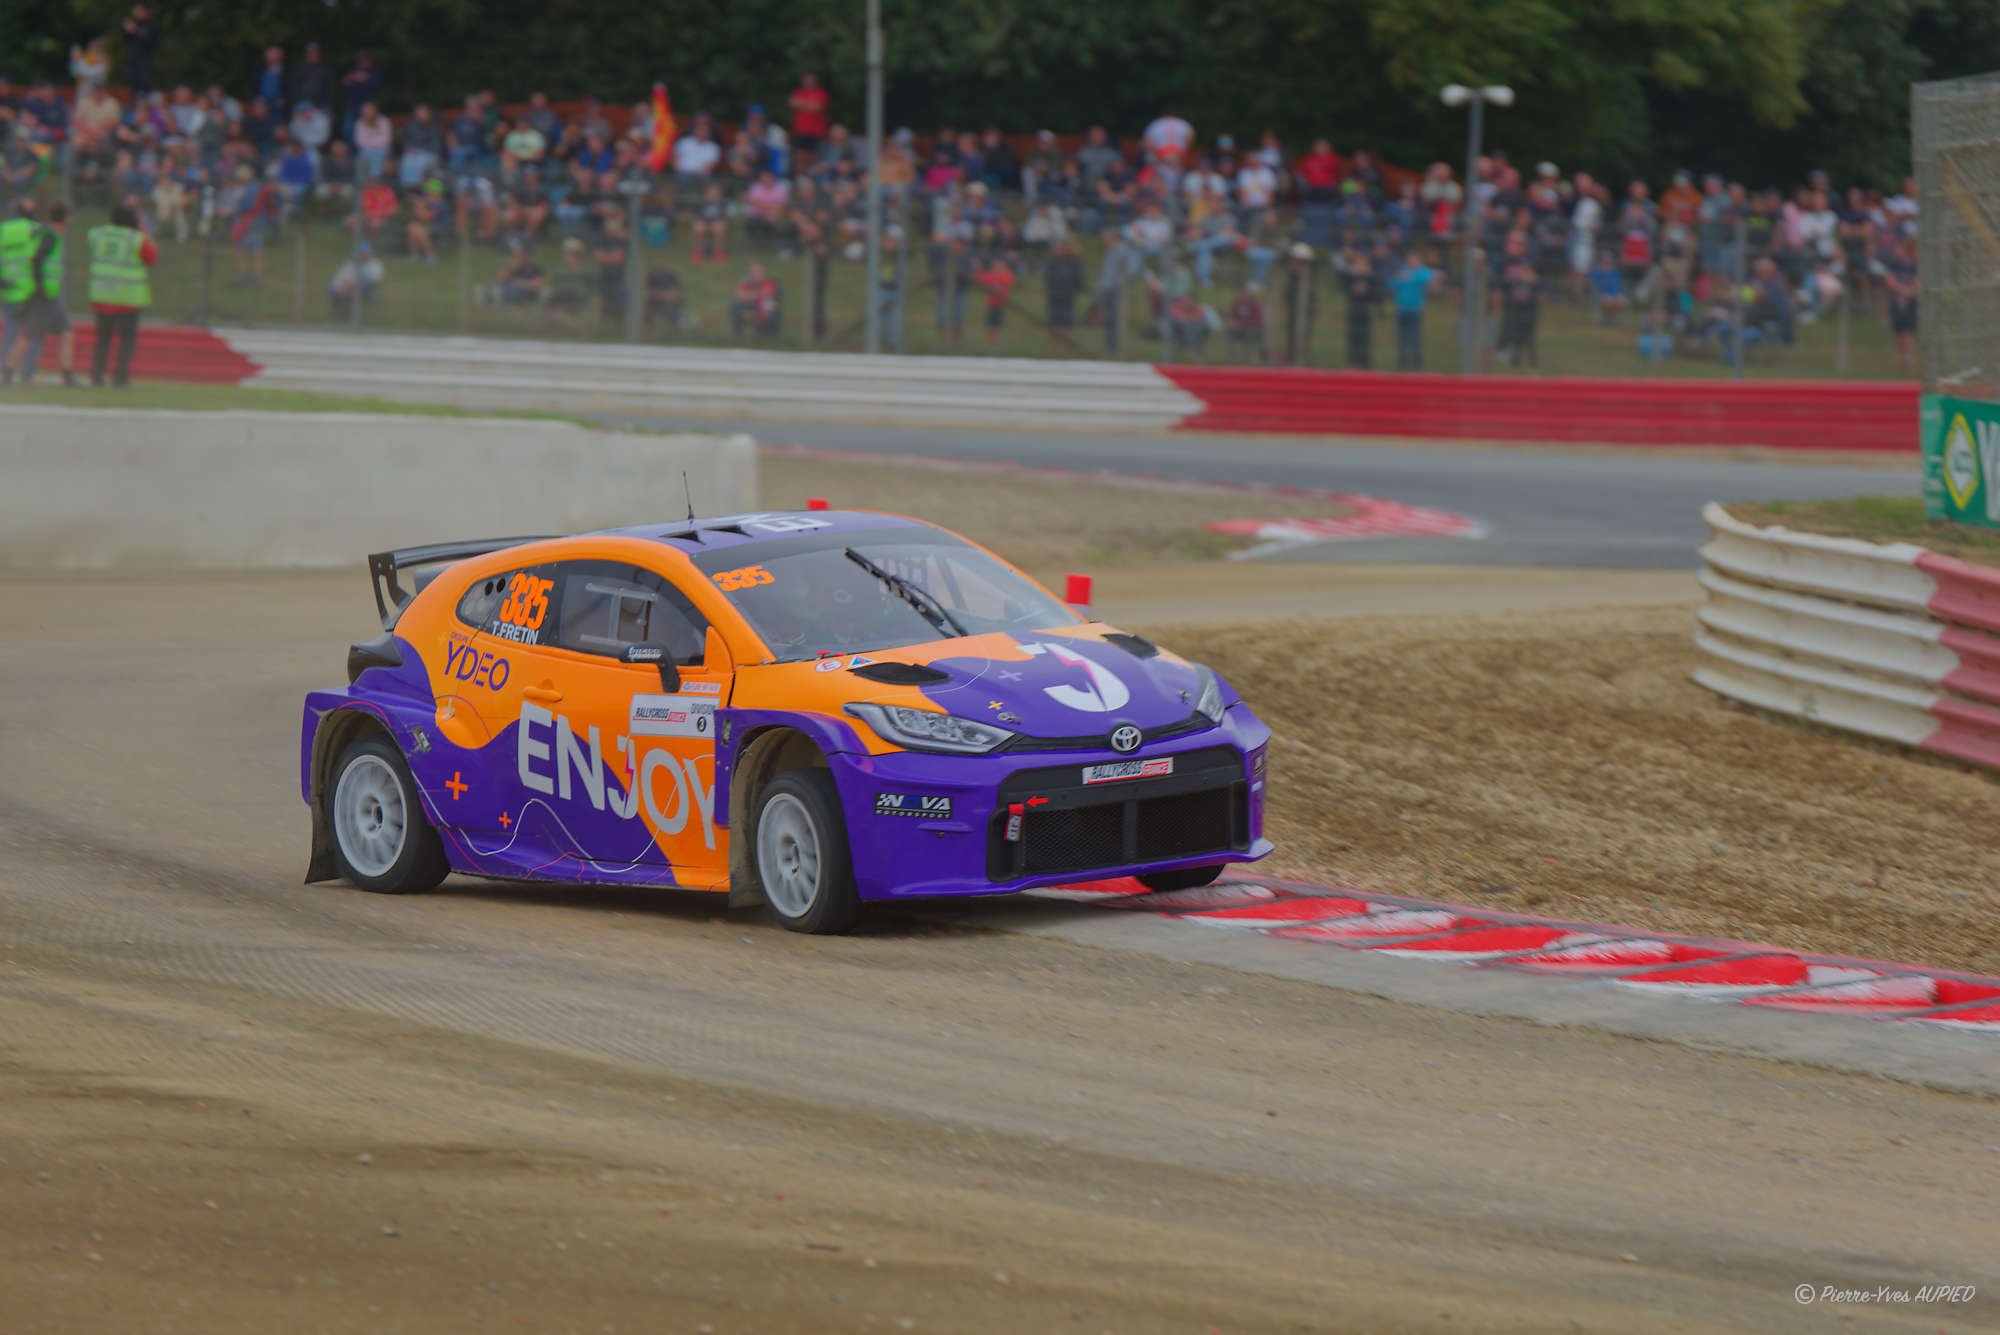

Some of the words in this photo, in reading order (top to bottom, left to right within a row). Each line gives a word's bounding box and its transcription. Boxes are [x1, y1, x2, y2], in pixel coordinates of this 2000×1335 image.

[500, 573, 555, 630] 335
[712, 565, 775, 591] 335
[491, 620, 540, 645] T.FRETIN
[444, 641, 510, 691] YDEO
[518, 700, 716, 851] ENJOY
